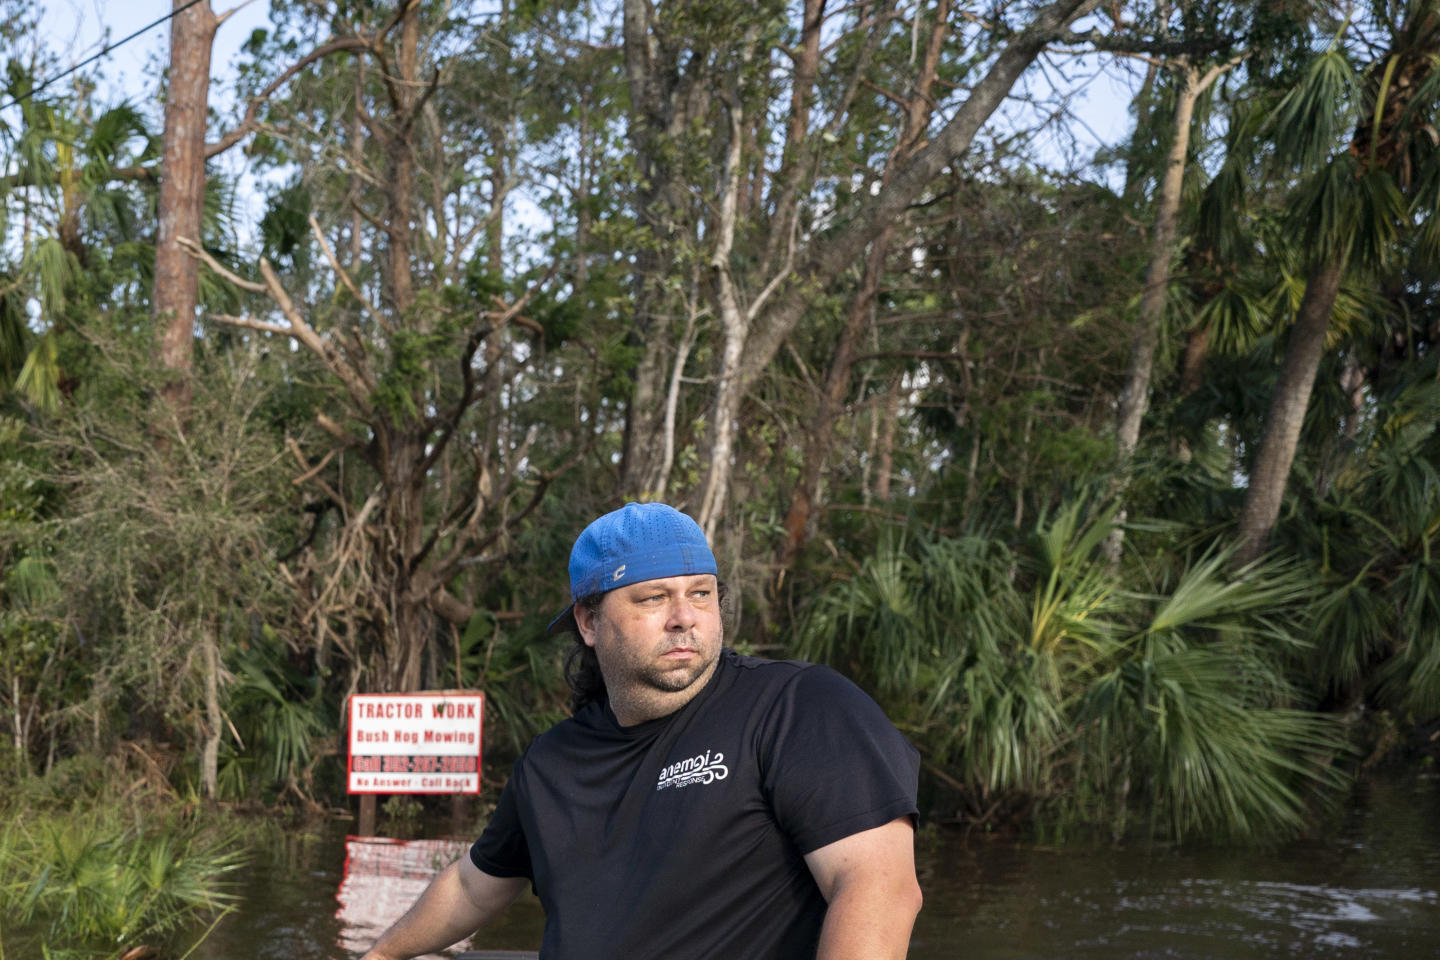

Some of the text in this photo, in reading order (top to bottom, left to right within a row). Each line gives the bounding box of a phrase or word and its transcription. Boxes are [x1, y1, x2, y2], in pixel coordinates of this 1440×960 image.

[358, 702, 475, 719] TRACTOR WORK
[357, 729, 475, 745] Bush Hog Mowing
[658, 749, 711, 780] anemoi
[357, 777, 369, 786] No
[373, 777, 411, 787] Answer
[421, 777, 442, 787] Call
[446, 777, 471, 787] Back
